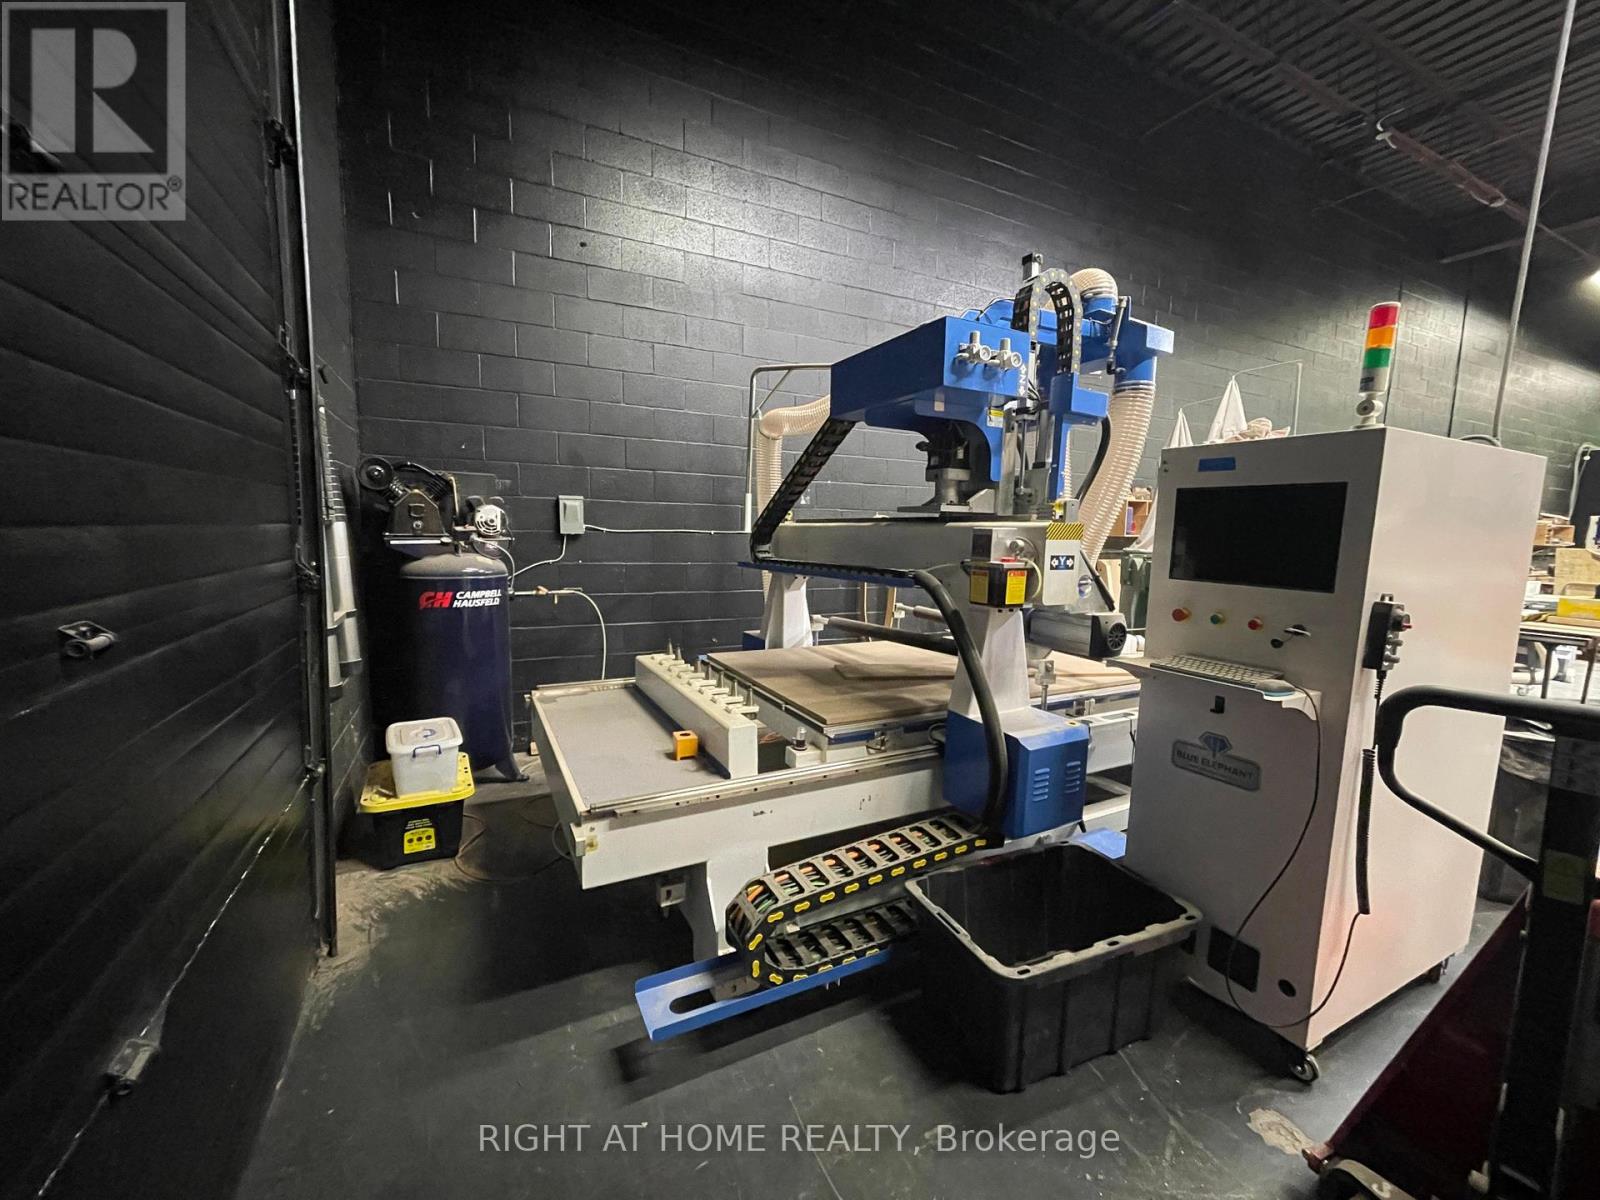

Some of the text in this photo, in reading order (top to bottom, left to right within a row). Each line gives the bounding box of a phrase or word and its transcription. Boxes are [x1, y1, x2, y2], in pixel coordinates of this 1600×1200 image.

[456, 589, 502, 599] CAMPBELL
[453, 598, 500, 608] HAUSFELD
[1176, 749, 1200, 764] BLUE
[1201, 757, 1254, 779] ELEPHANT
